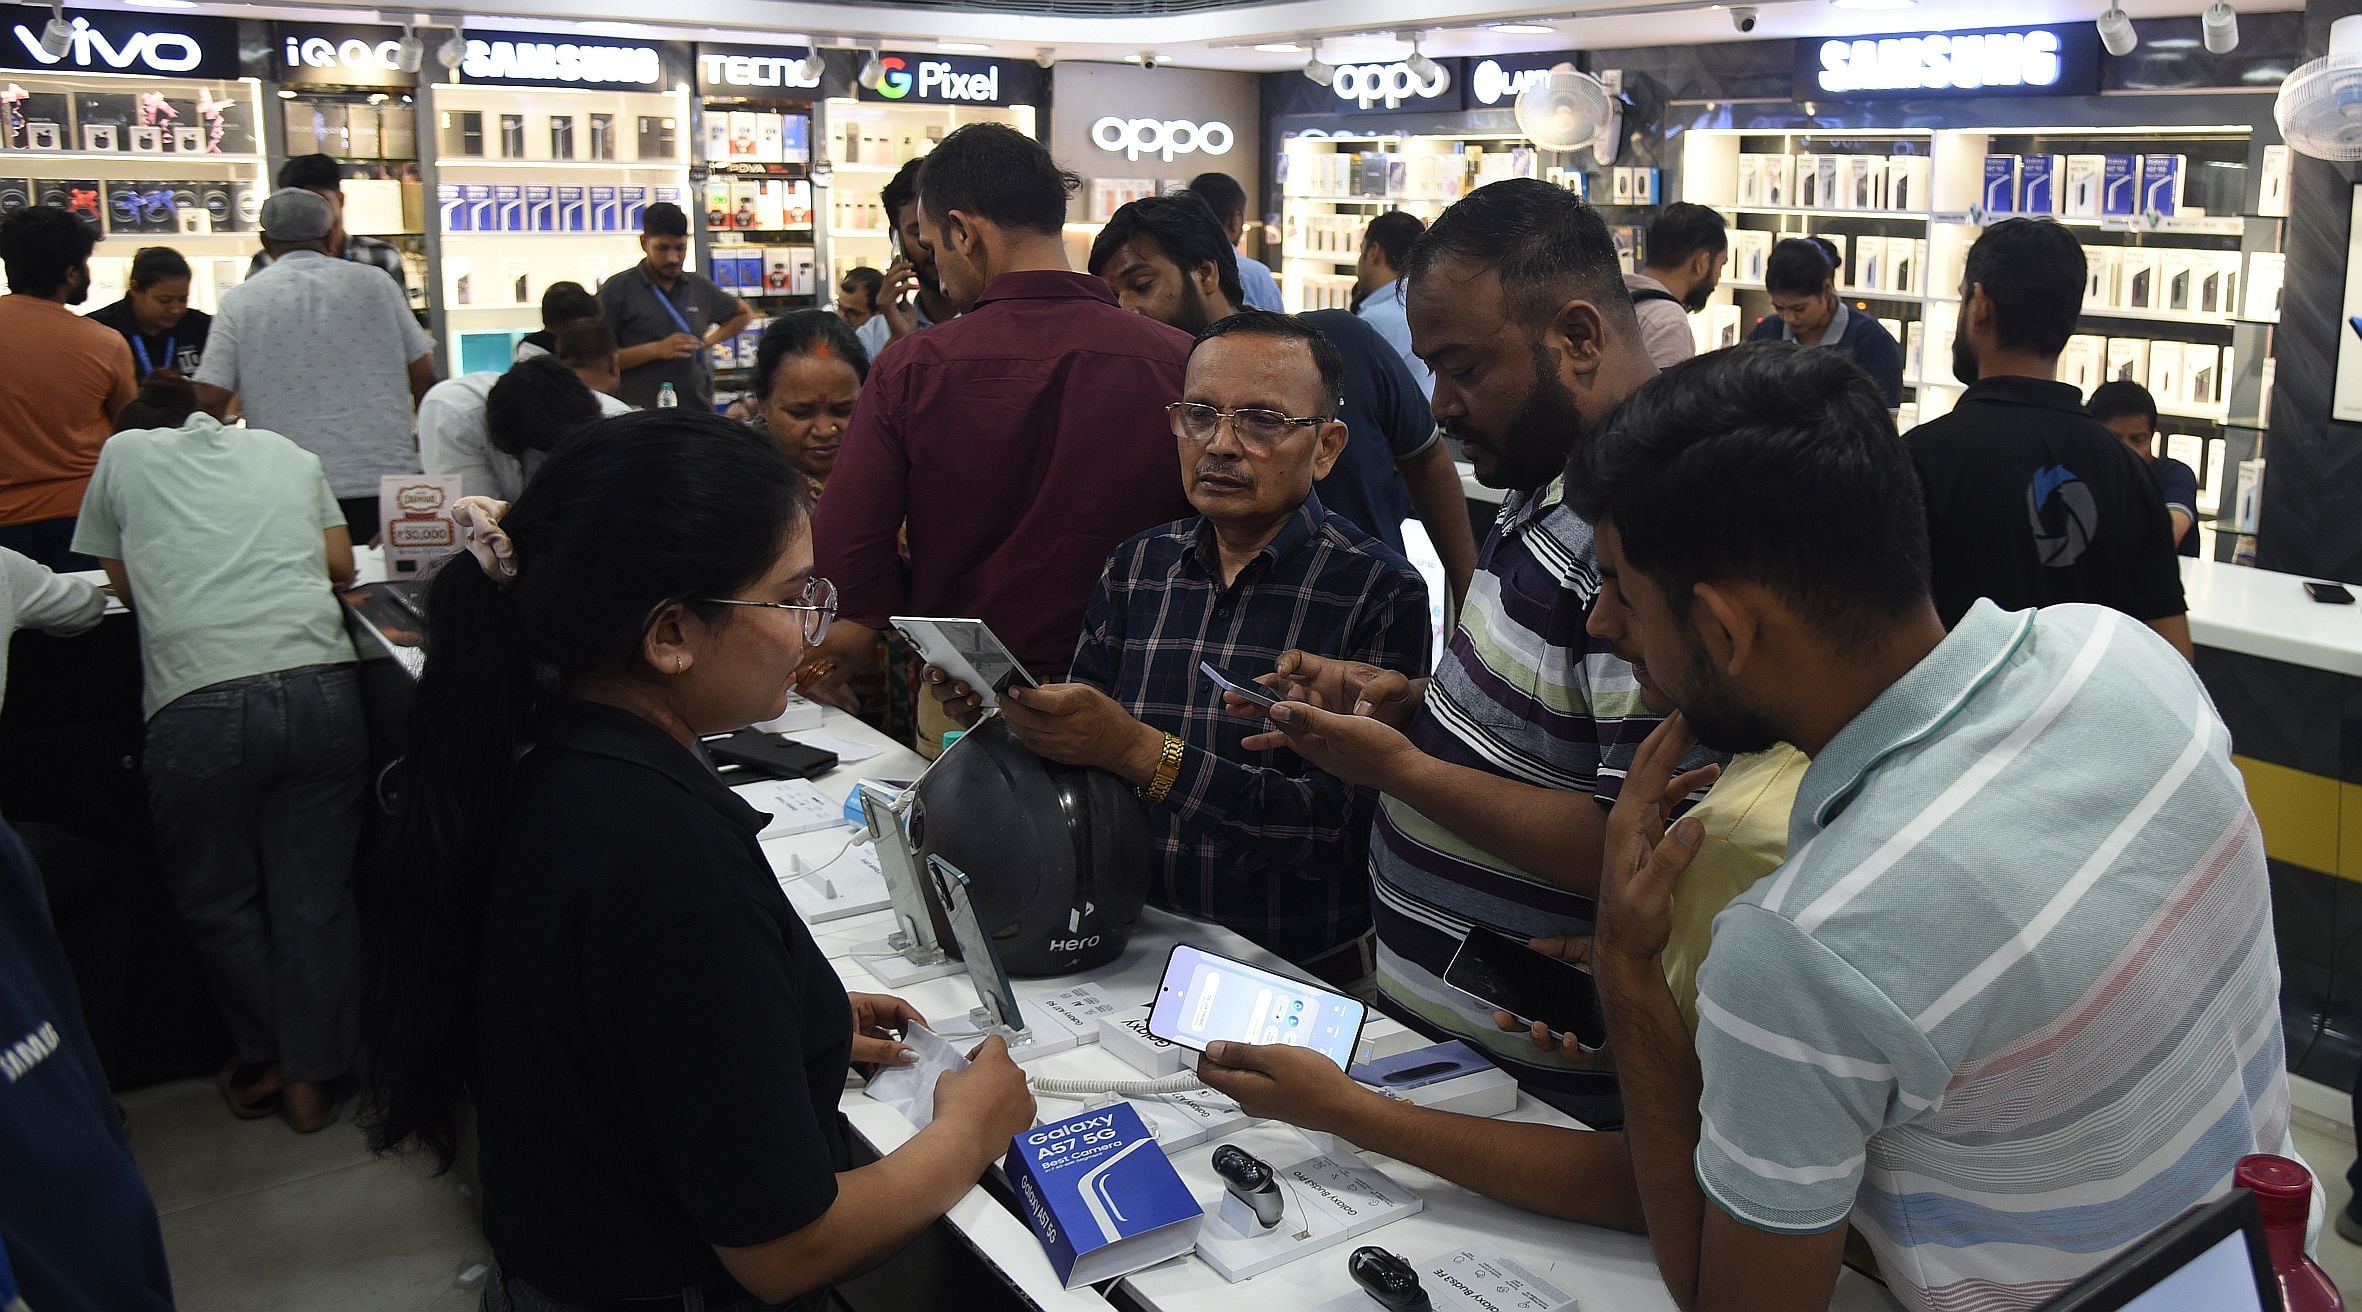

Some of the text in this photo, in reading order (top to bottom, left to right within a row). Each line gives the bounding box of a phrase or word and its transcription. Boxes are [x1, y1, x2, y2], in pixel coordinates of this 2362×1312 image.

[463, 42, 660, 85] SAMSUNG
[1819, 30, 2060, 92] SAMSUNG
[917, 60, 999, 102] Pixel
[727, 163, 767, 174] POVA
[1187, 1099, 1211, 1118] Galaxy
[1028, 1113, 1113, 1146] Galaxy
[1037, 1128, 1117, 1161] A57 5G
[1041, 1154, 1070, 1170] Best
[1072, 1139, 1123, 1159] Camera
[1293, 1171, 1307, 1182] Pro
[1021, 1175, 1057, 1244] Galaxy A57 5G
[1328, 1195, 1358, 1216] Galaxy
[1433, 1268, 1448, 1278] FE
[1444, 1276, 1474, 1296] Buds3
[1471, 1294, 1500, 1312] alaxy
